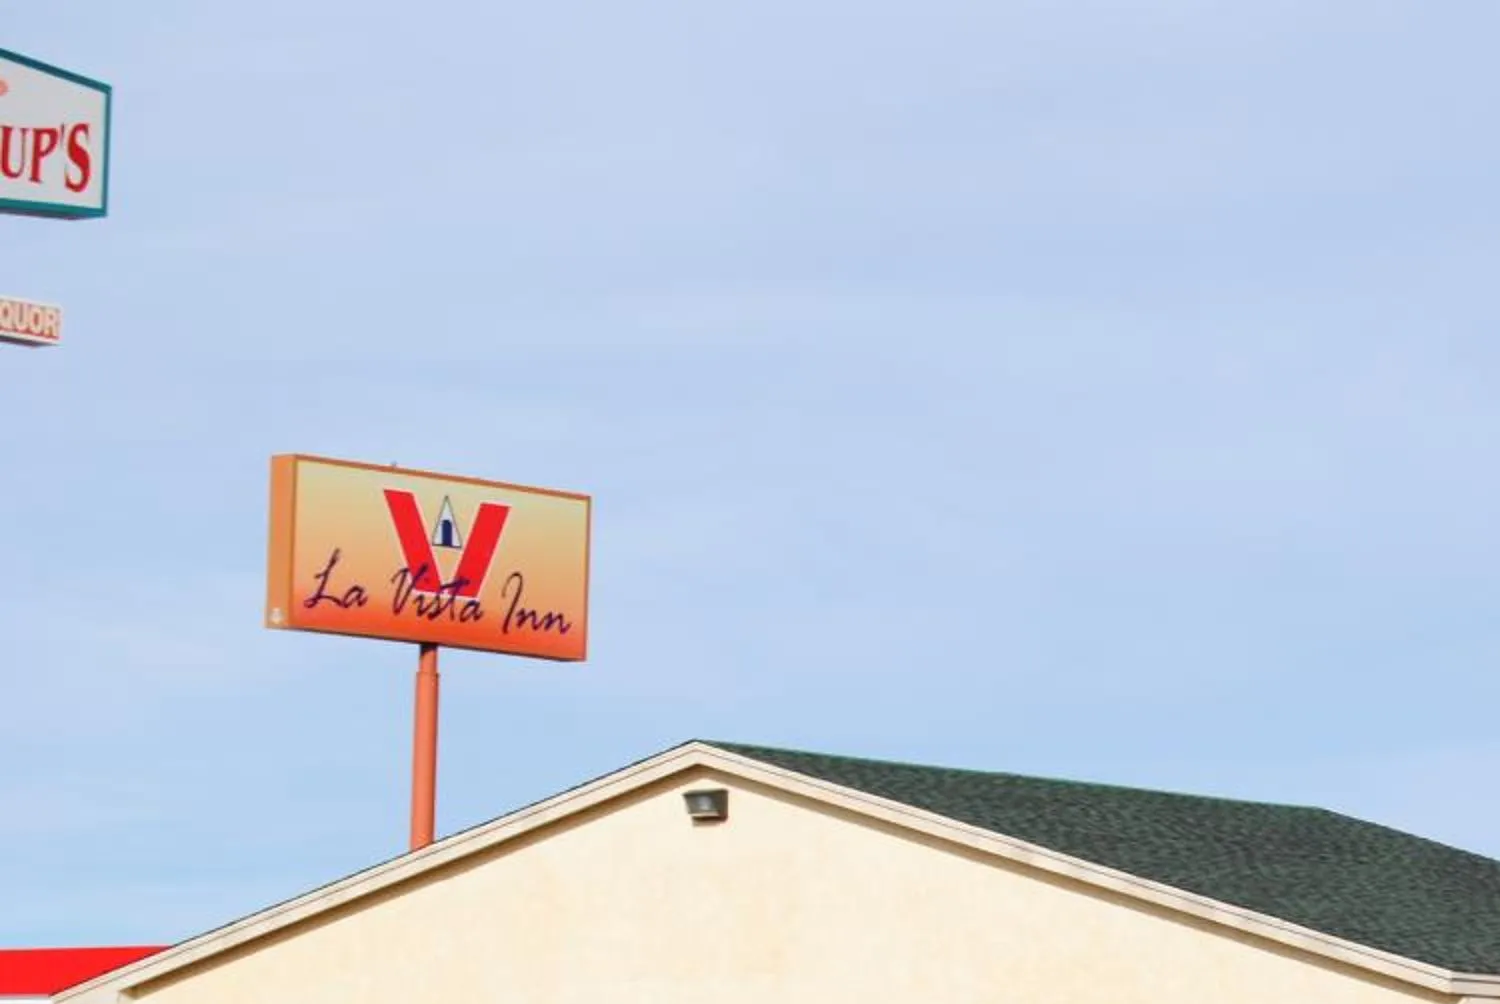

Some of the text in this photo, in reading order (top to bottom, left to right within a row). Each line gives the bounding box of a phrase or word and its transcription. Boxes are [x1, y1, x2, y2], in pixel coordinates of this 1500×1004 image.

[303, 547, 571, 634] La Vista Inn
